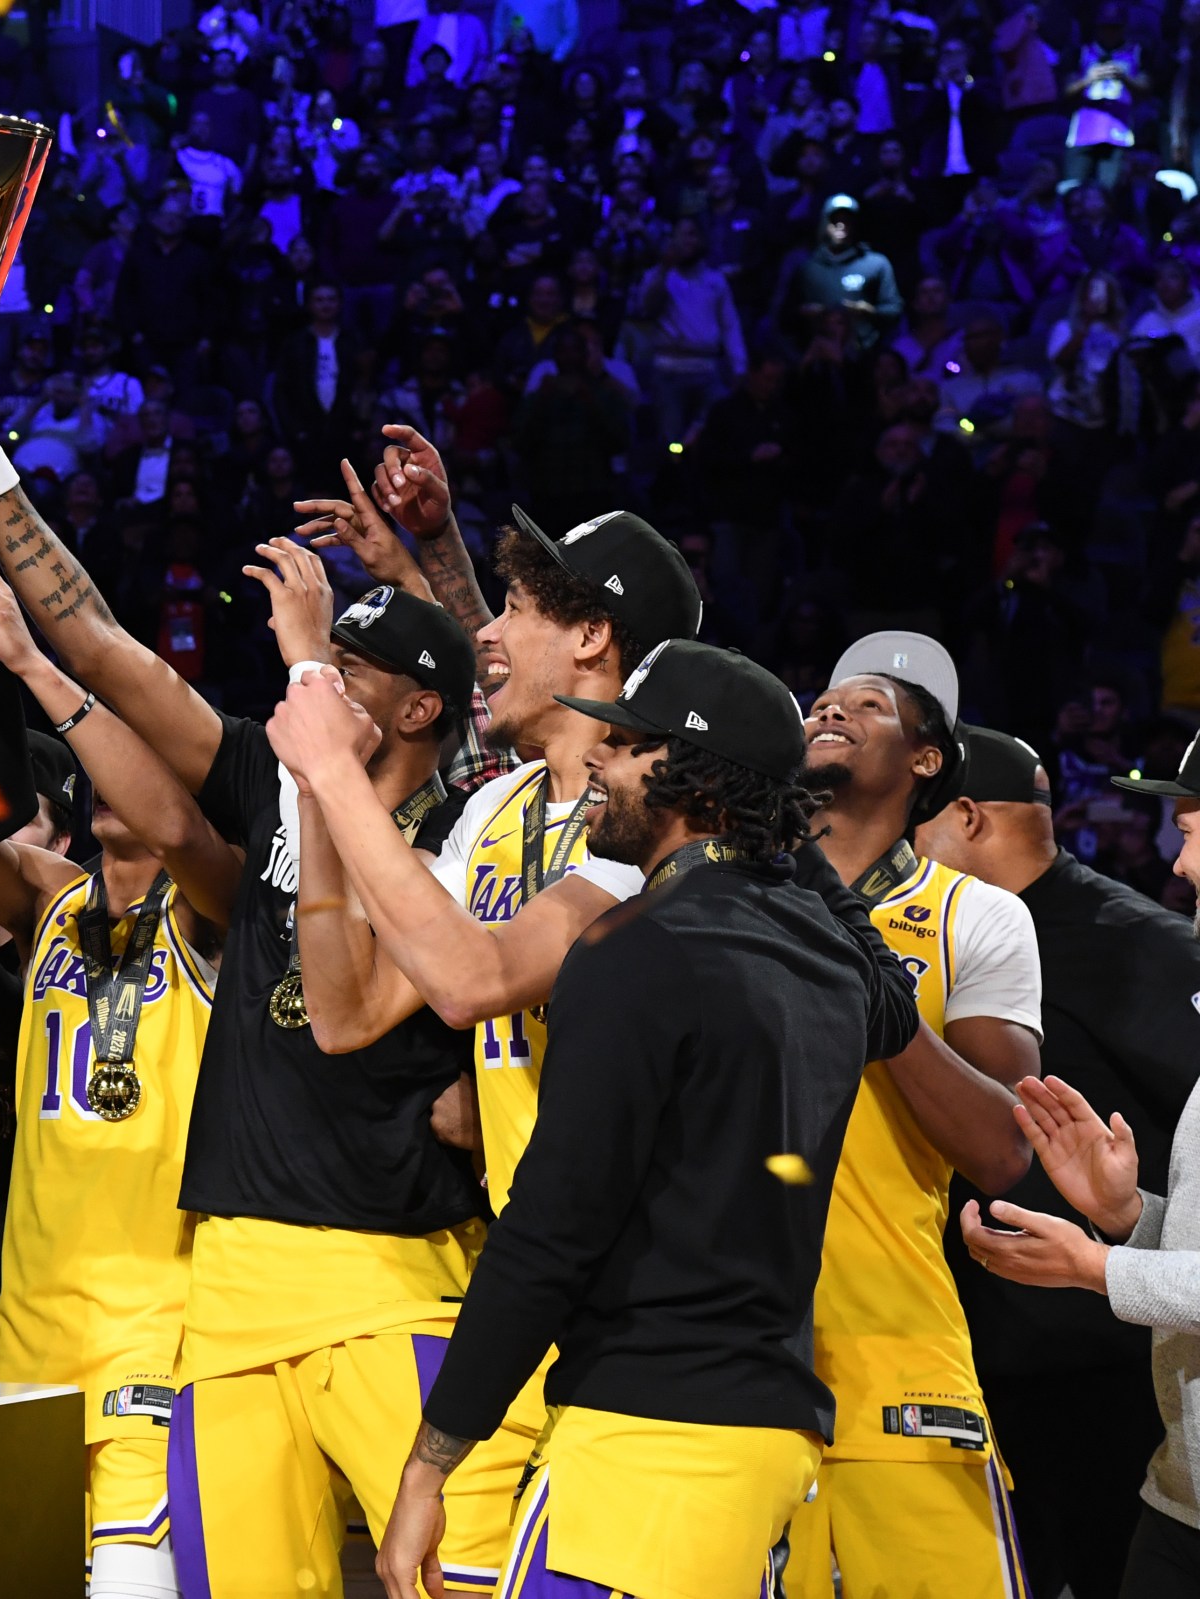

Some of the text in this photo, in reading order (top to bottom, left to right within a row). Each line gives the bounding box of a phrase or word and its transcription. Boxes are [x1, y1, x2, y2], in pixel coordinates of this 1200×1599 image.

[551, 821, 580, 871] CHAMPIONS
[647, 861, 677, 892] MPIONS
[889, 918, 937, 939] bibigo
[33, 936, 170, 1005] LAKS
[110, 1029, 127, 1053] 2023
